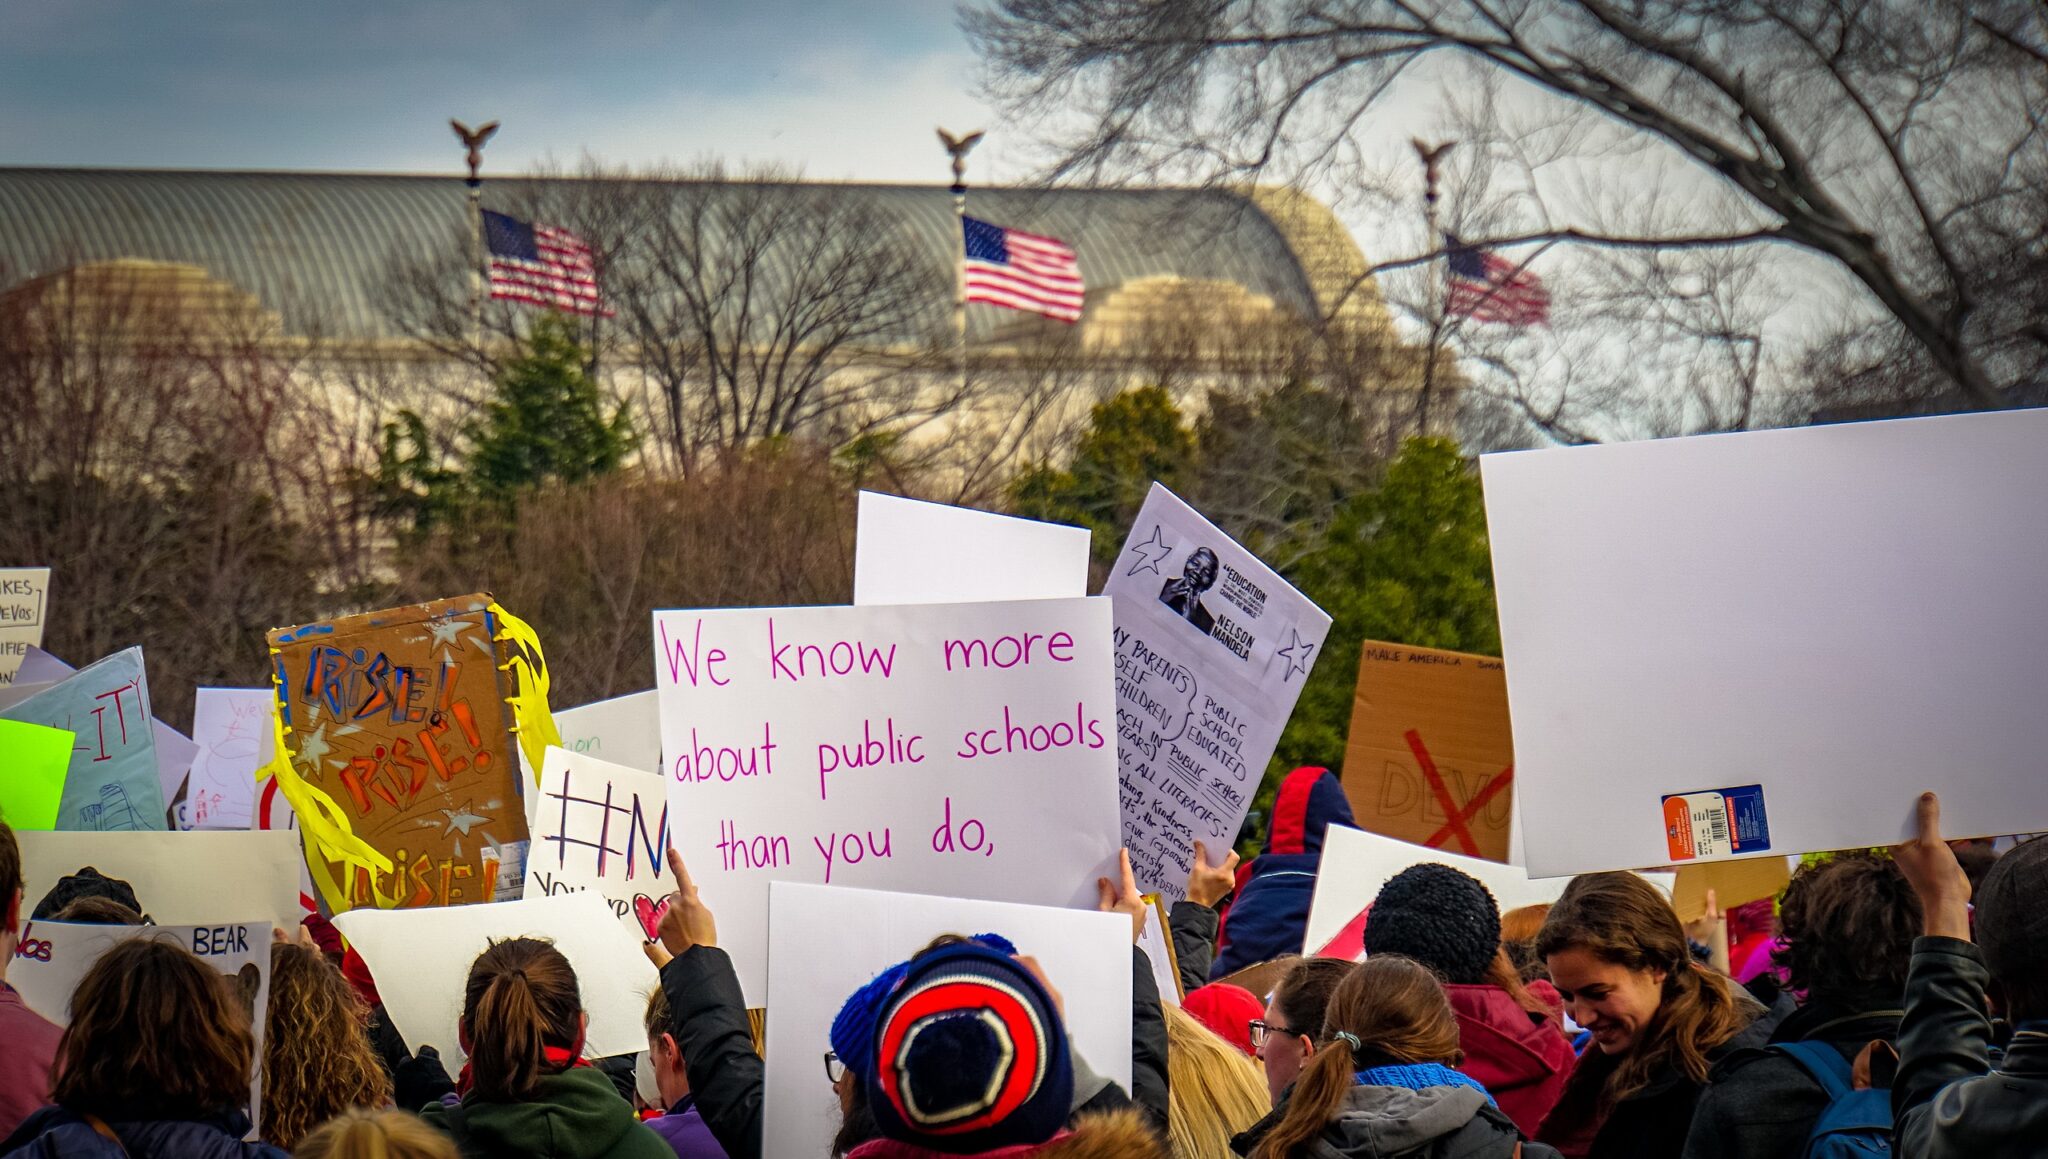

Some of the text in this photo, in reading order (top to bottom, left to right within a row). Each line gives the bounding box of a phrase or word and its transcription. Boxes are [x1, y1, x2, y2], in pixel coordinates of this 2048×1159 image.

[1219, 588, 1237, 603] CHANGE
[1234, 599, 1244, 609] THE
[660, 617, 1074, 686] We know more
[1211, 626, 1249, 662] MANDELA
[1217, 614, 1256, 648] NELSON
[1114, 652, 1152, 684] SELF
[1132, 640, 1189, 693] PARENTS
[1368, 649, 1400, 662] MAKE
[1408, 653, 1462, 666] AMERICA
[1200, 713, 1244, 761] SCHOOL
[1205, 695, 1247, 737] PUBLIC
[676, 702, 1104, 800] about public schools
[1151, 731, 1162, 748] IN
[1170, 744, 1208, 779] PUBLIC
[1211, 778, 1245, 809] SCHOOL
[1187, 726, 1246, 781] EDUCATED
[1135, 763, 1156, 785] ALL
[1159, 778, 1229, 838] LITERACIES:
[1143, 812, 1157, 828] the
[1152, 799, 1192, 841] Kindness,
[716, 797, 993, 884] than you do,
[192, 926, 249, 956] BEAR
